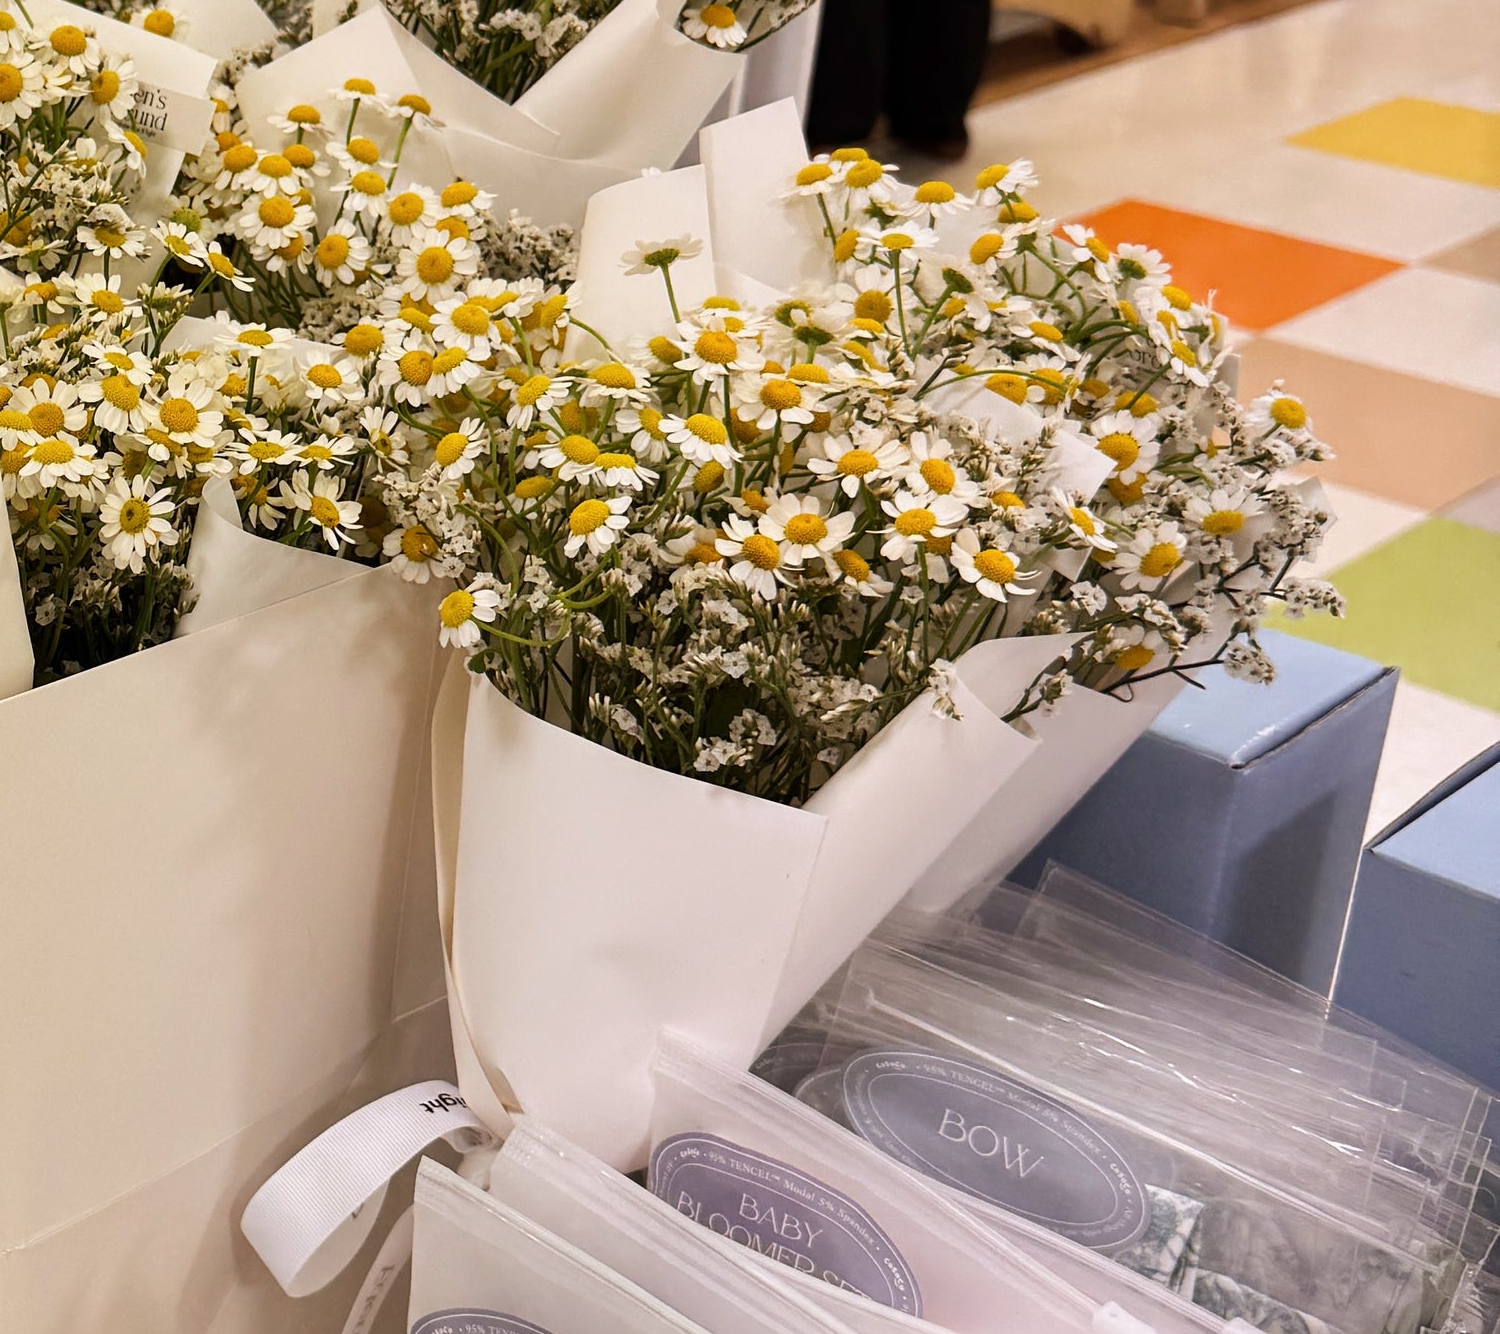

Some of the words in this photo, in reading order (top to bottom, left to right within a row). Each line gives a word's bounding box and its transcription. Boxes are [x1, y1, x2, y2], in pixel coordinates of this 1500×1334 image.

[936, 1108, 1046, 1178] BOW
[1060, 1120, 1102, 1153] Spandex
[708, 1149, 728, 1166] 95%
[782, 1178, 817, 1203] Modal
[818, 1197, 835, 1212] 5%
[836, 1206, 876, 1247] Spandex
[738, 1193, 824, 1249] BABY
